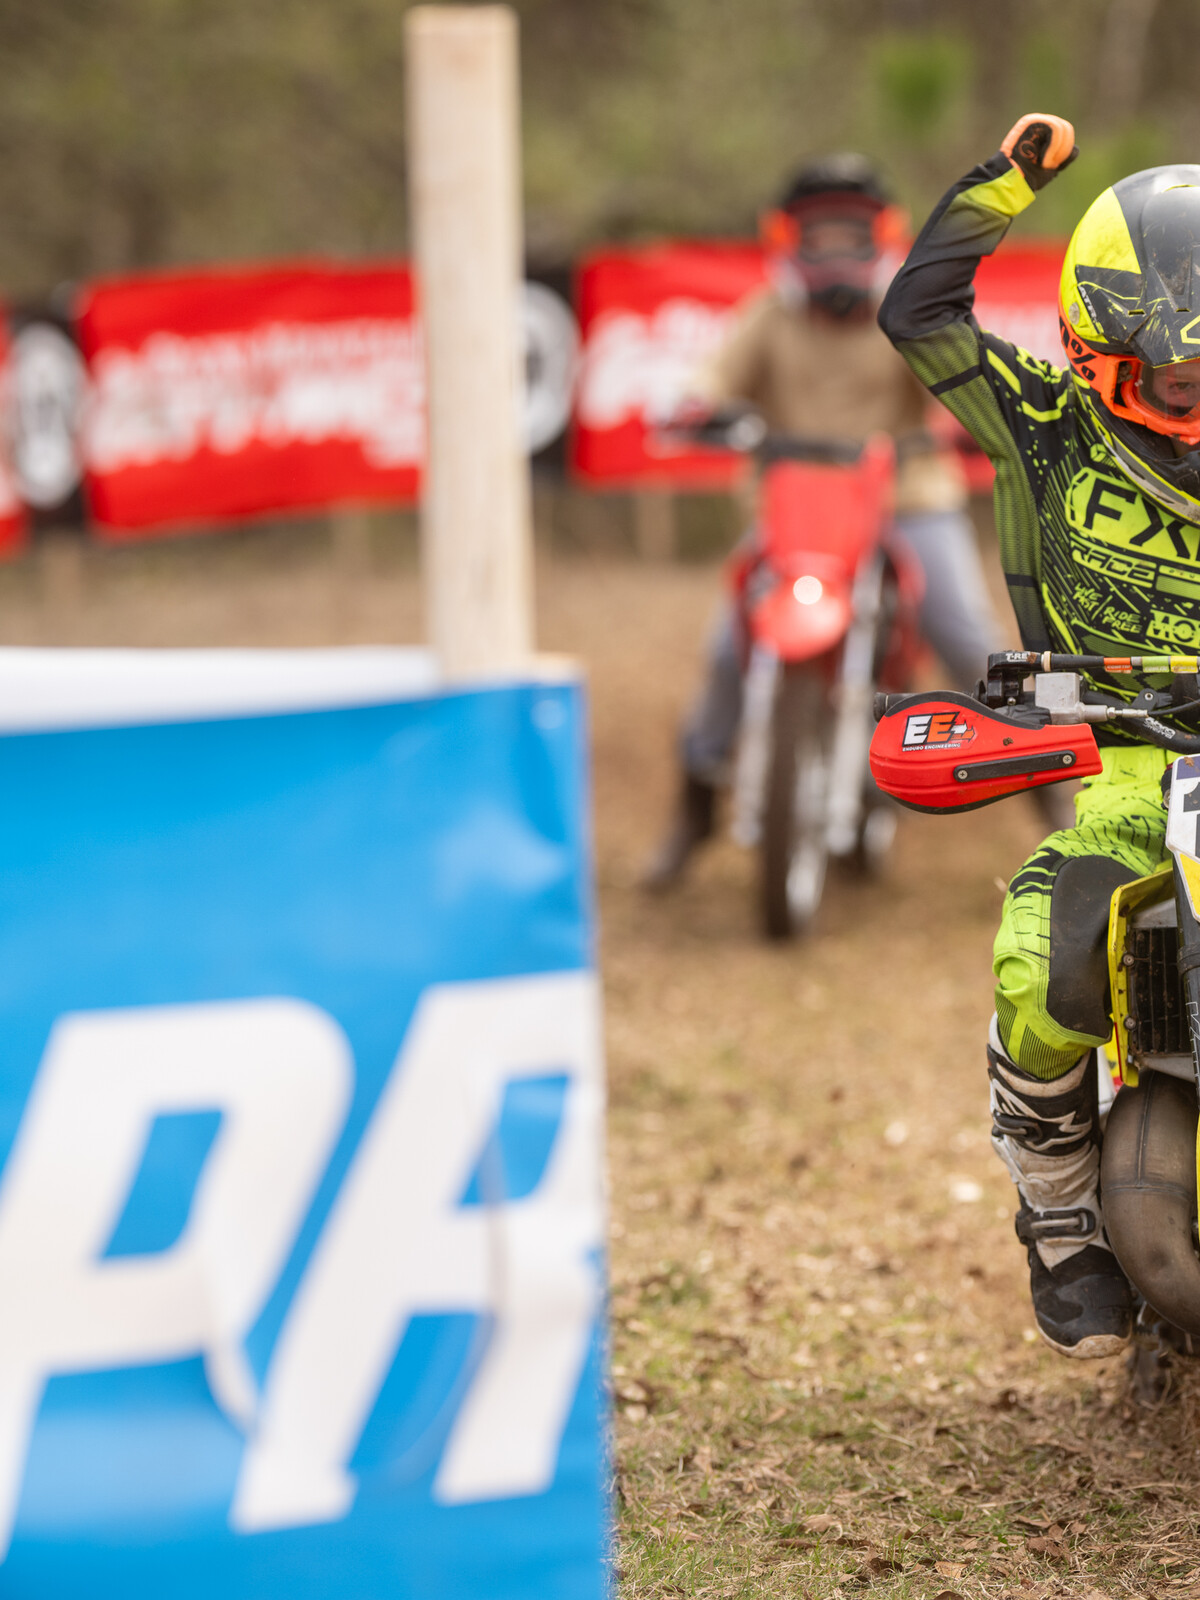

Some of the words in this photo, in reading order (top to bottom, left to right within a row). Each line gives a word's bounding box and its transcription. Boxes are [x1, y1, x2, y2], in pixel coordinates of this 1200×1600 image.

[1103, 606, 1141, 623] RIDE
[1102, 616, 1143, 633] FREE
[1005, 652, 1037, 663] T-RE
[902, 712, 960, 747] EE
